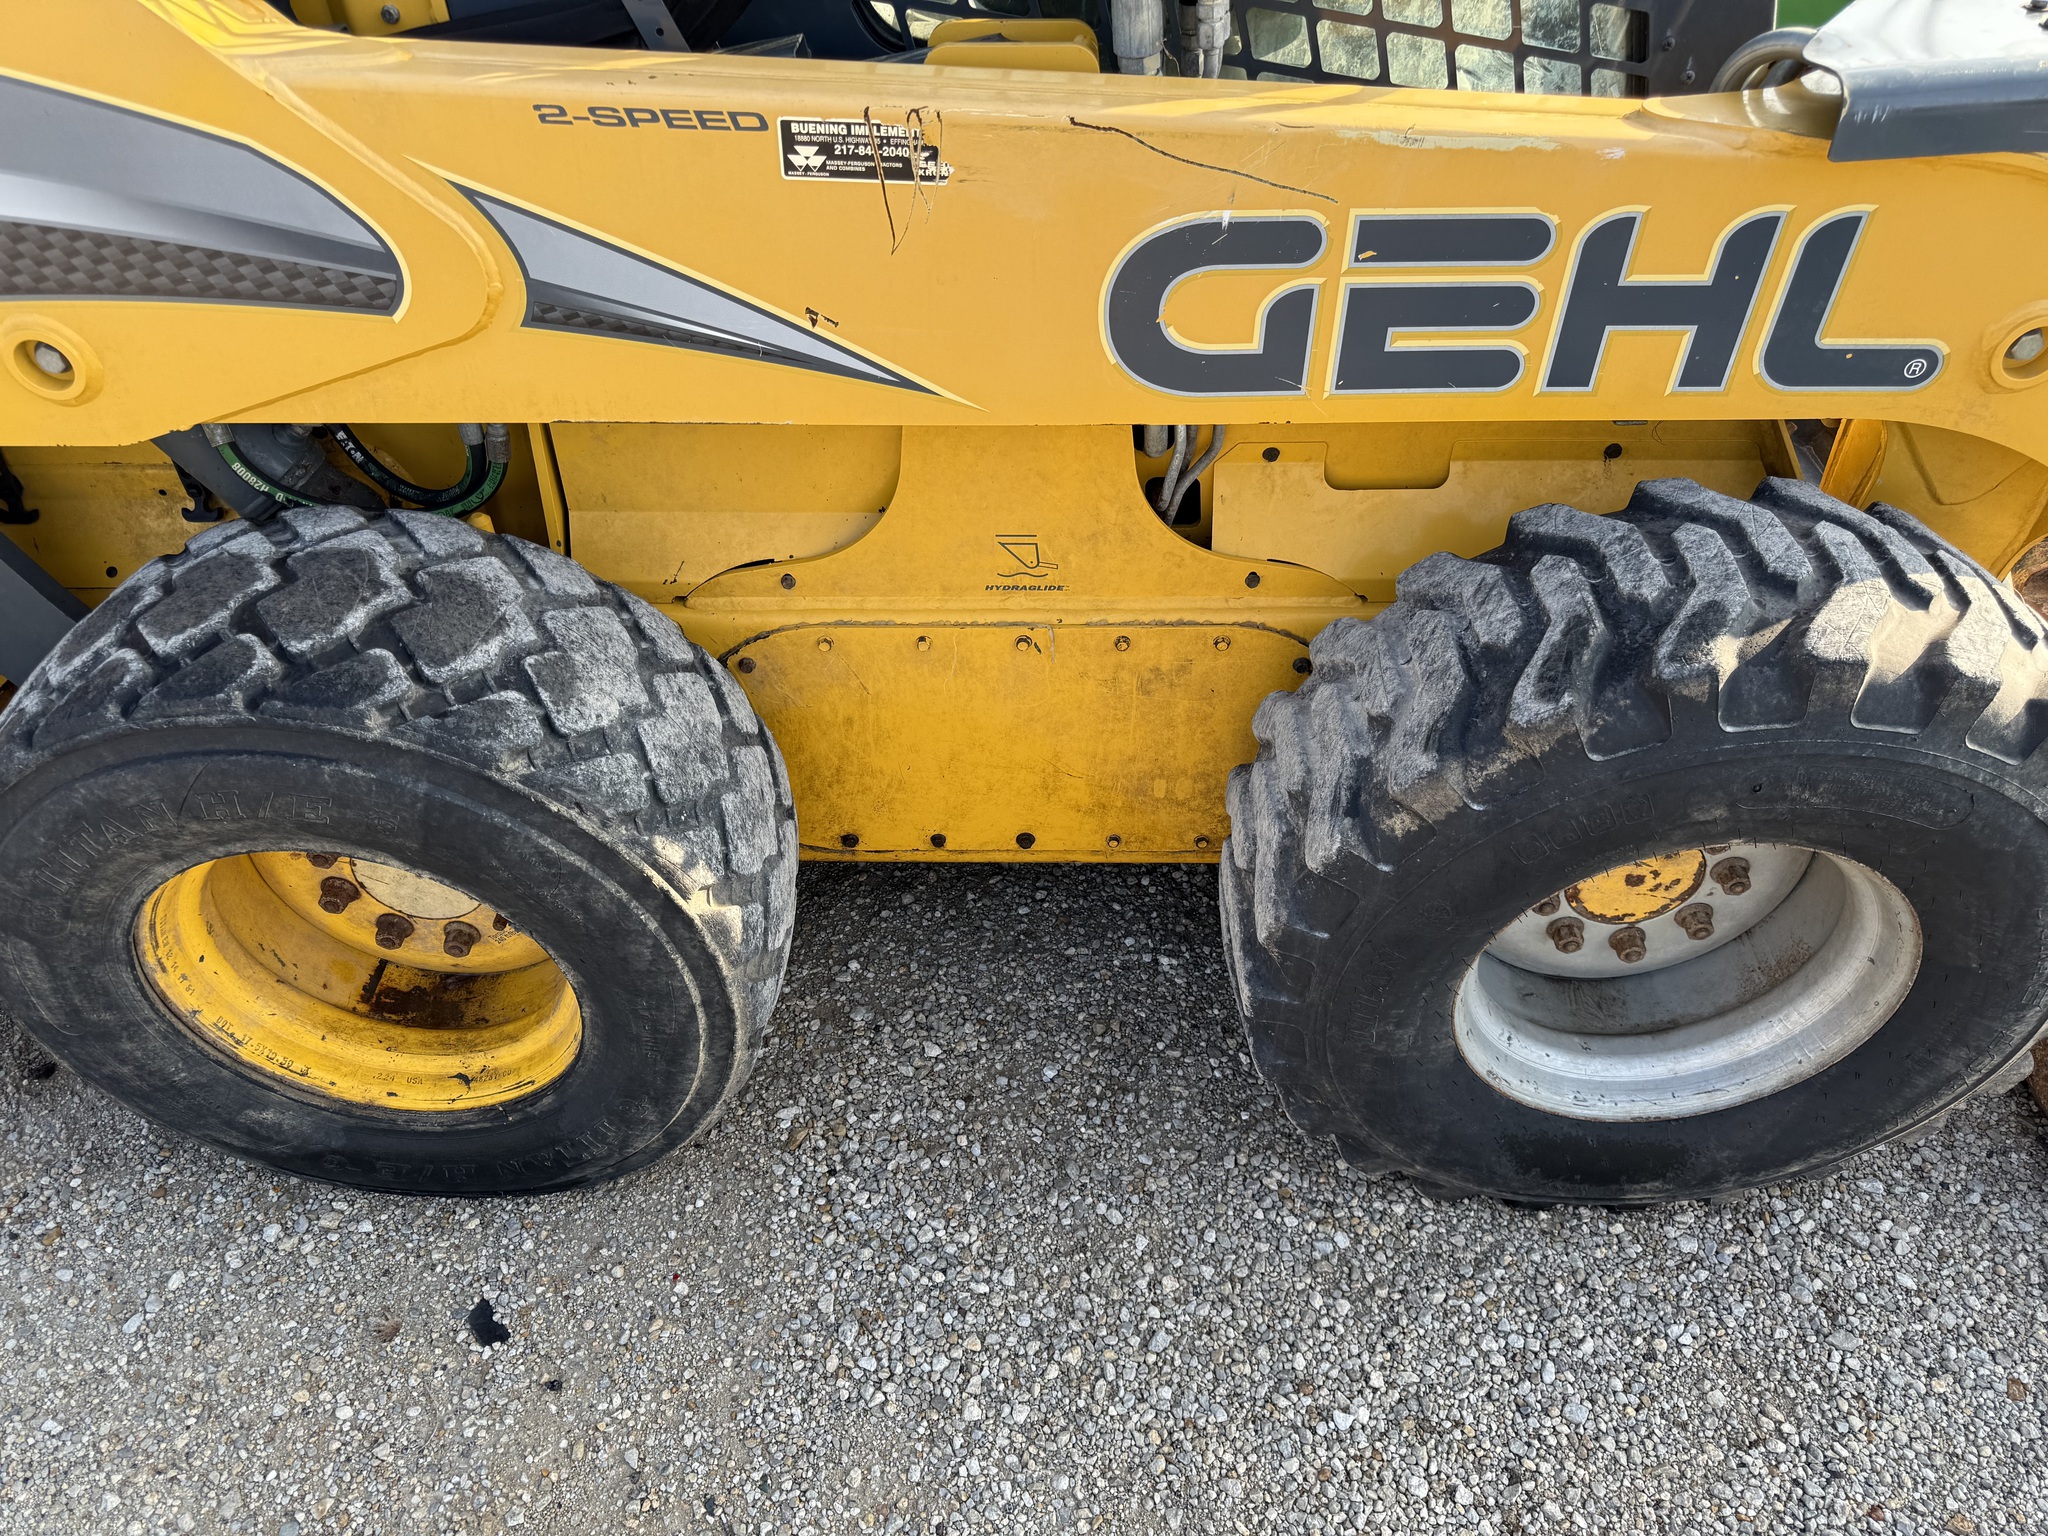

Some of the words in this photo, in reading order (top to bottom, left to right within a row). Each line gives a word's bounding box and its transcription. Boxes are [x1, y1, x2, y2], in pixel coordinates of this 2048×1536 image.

[532, 104, 770, 132] 2-SPEED
[790, 122, 848, 135] BUENING
[1098, 204, 1950, 399] GEHL
[984, 584, 1065, 592] HYDRAGLIDE
[406, 1076, 423, 1086] USA
